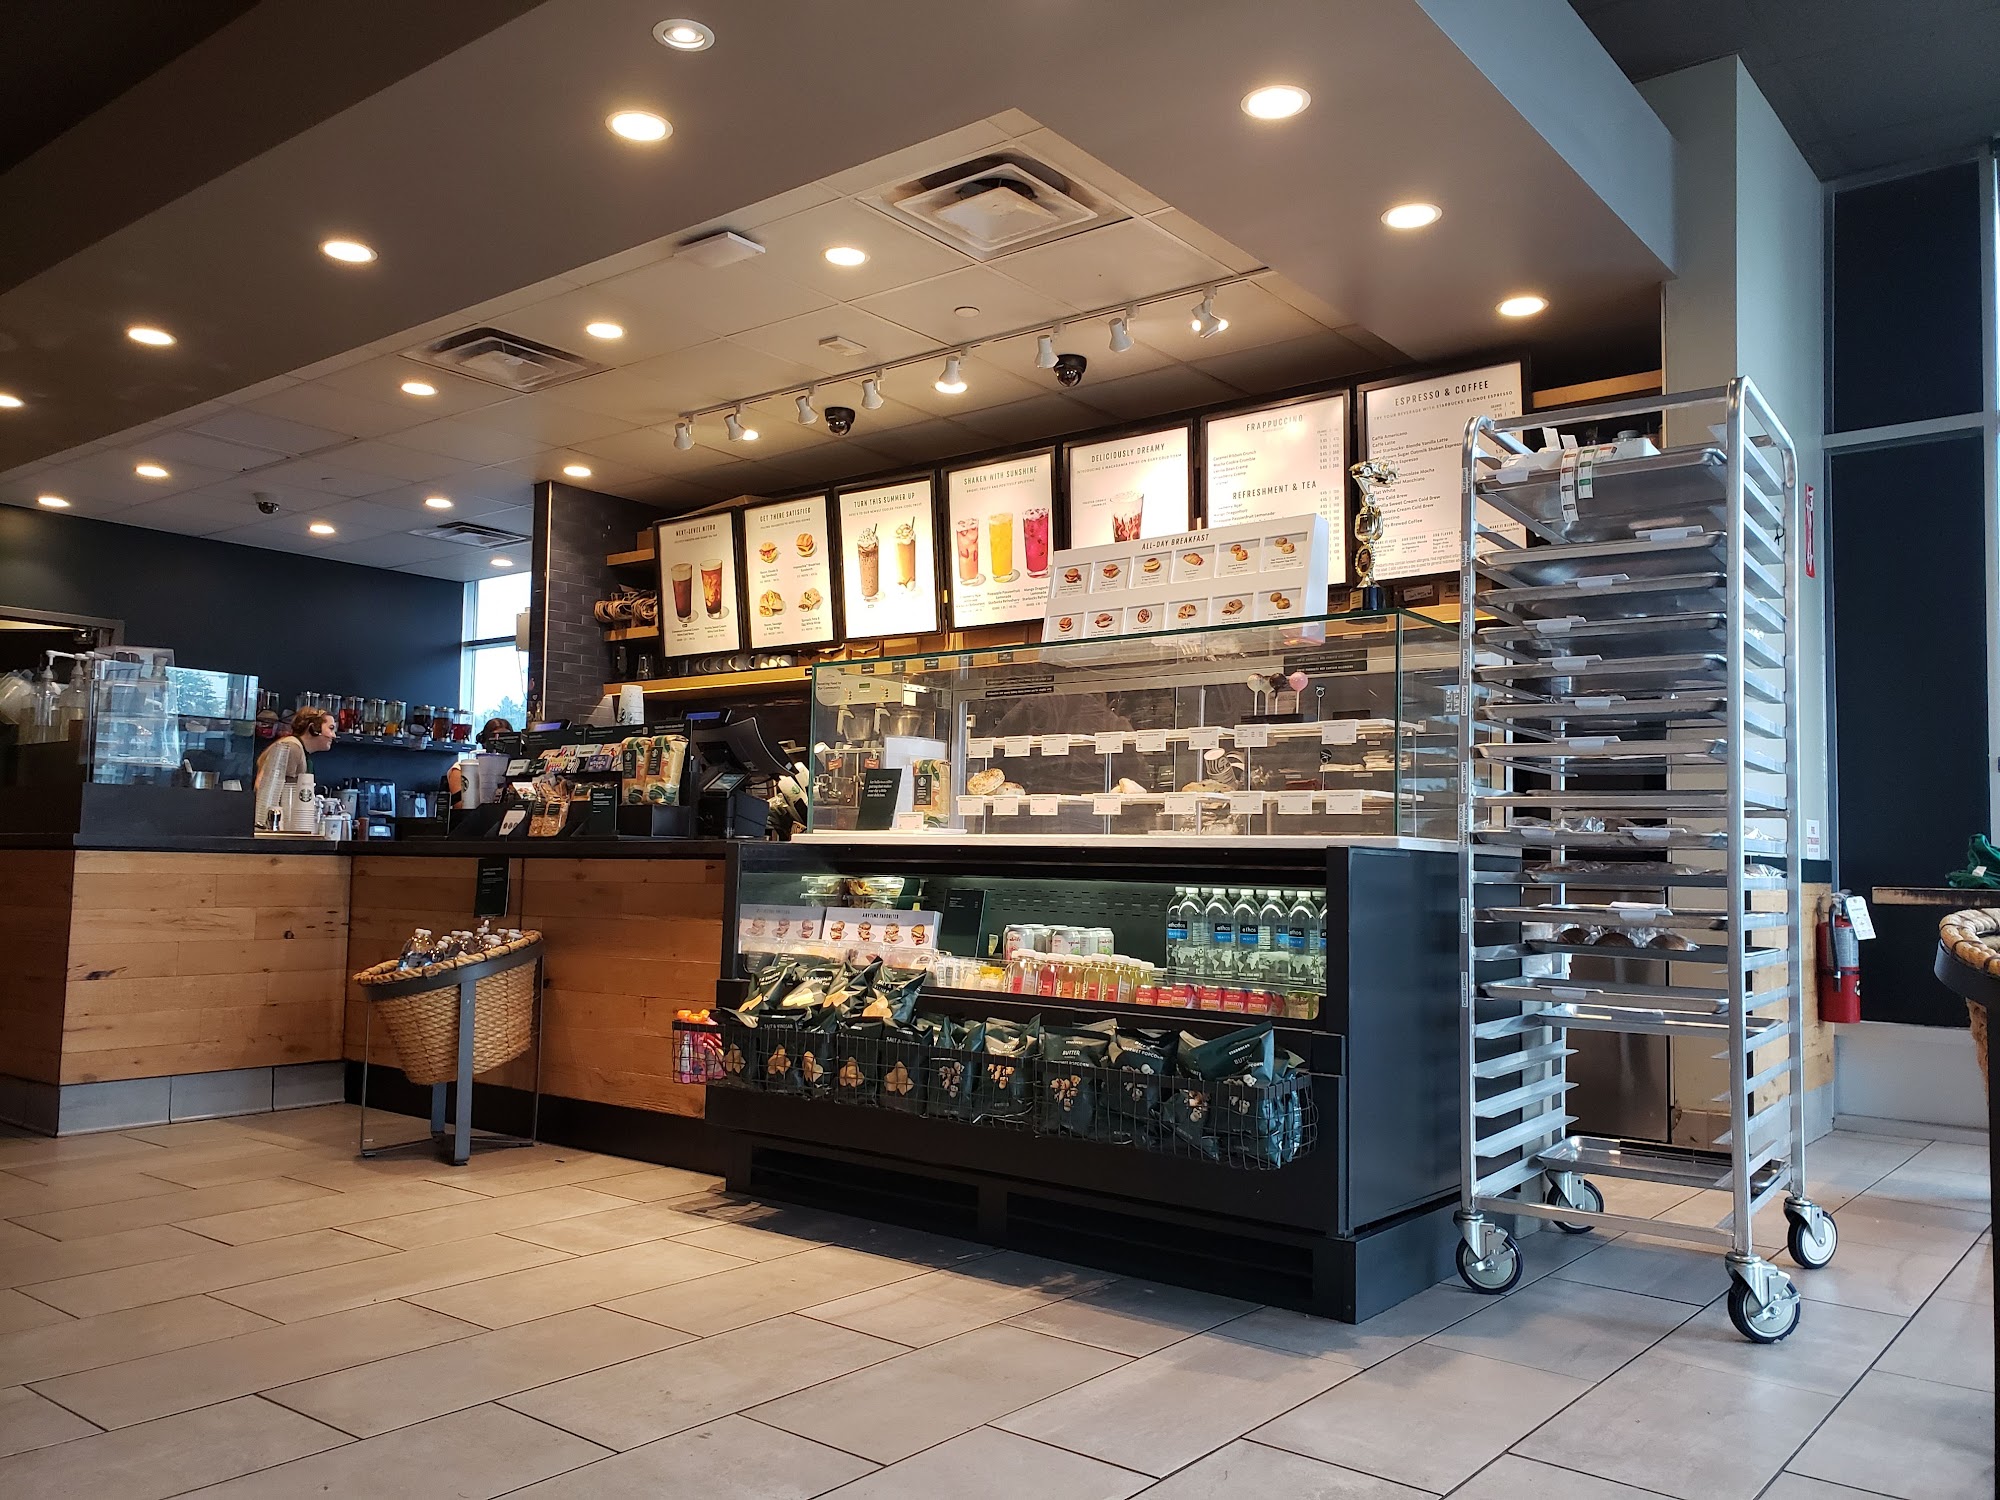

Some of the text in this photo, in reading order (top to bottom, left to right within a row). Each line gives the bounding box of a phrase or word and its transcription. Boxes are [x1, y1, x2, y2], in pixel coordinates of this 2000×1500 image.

[1395, 380, 1488, 406] ESPRESSO & COFFEE
[1488, 390, 1513, 400] ESPRESSO
[1246, 415, 1302, 432] FRAPPUCCINO
[1092, 444, 1164, 462] DELICIOUSLY DREAMY
[964, 466, 1037, 486] SHAKEN WITH SUNSHINE
[1232, 484, 1288, 500] REFRESHMENT
[1302, 480, 1316, 490] TEA
[884, 494, 905, 504] SUMMER
[770, 512, 784, 520] THERE
[786, 507, 810, 518] SATISFIED
[1142, 534, 1209, 550] ALL-DAY BREAKFAST
[1142, 1052, 1164, 1061] POPCORN
[1228, 1043, 1250, 1056] STARBUCKS
